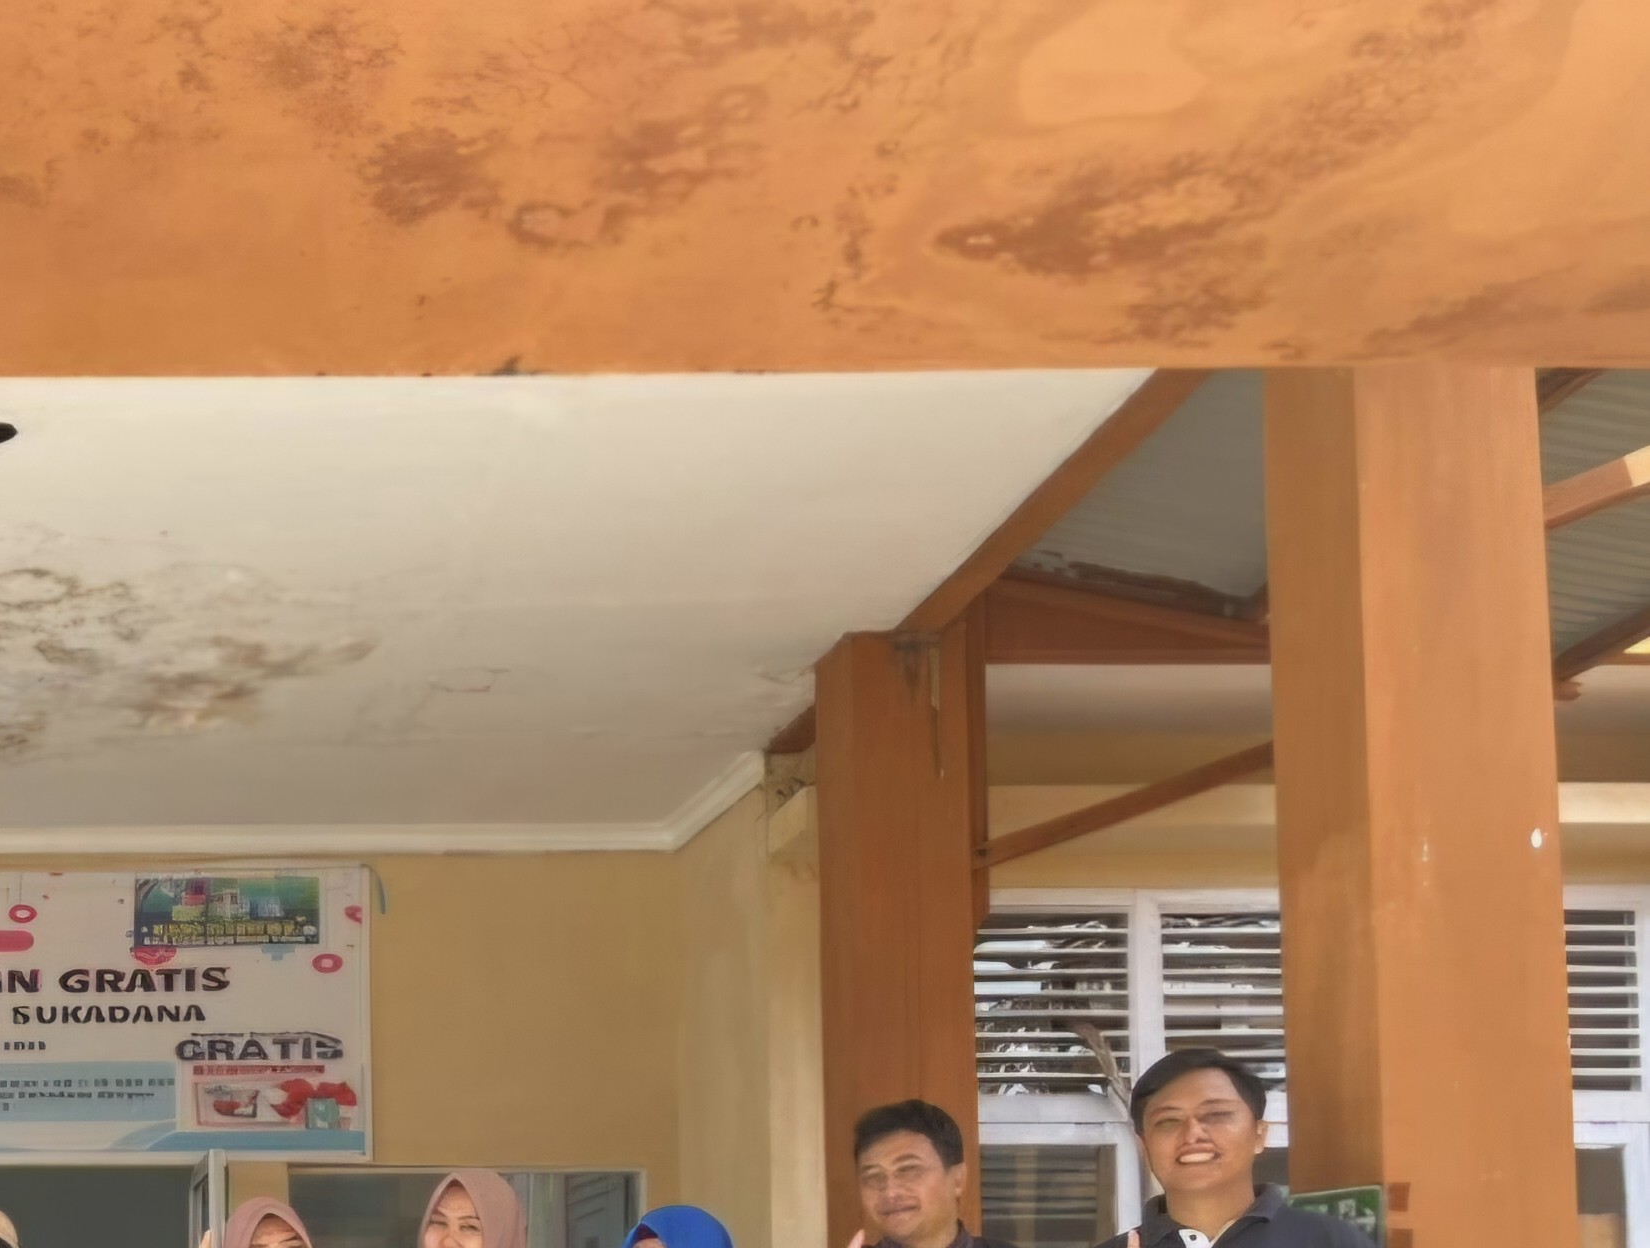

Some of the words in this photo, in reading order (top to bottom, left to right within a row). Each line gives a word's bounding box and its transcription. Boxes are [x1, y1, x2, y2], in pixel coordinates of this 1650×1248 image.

[58, 966, 230, 993] GRATIS
[12, 1004, 206, 1024] SUKADANA
[175, 1031, 344, 1061] GRATIS
